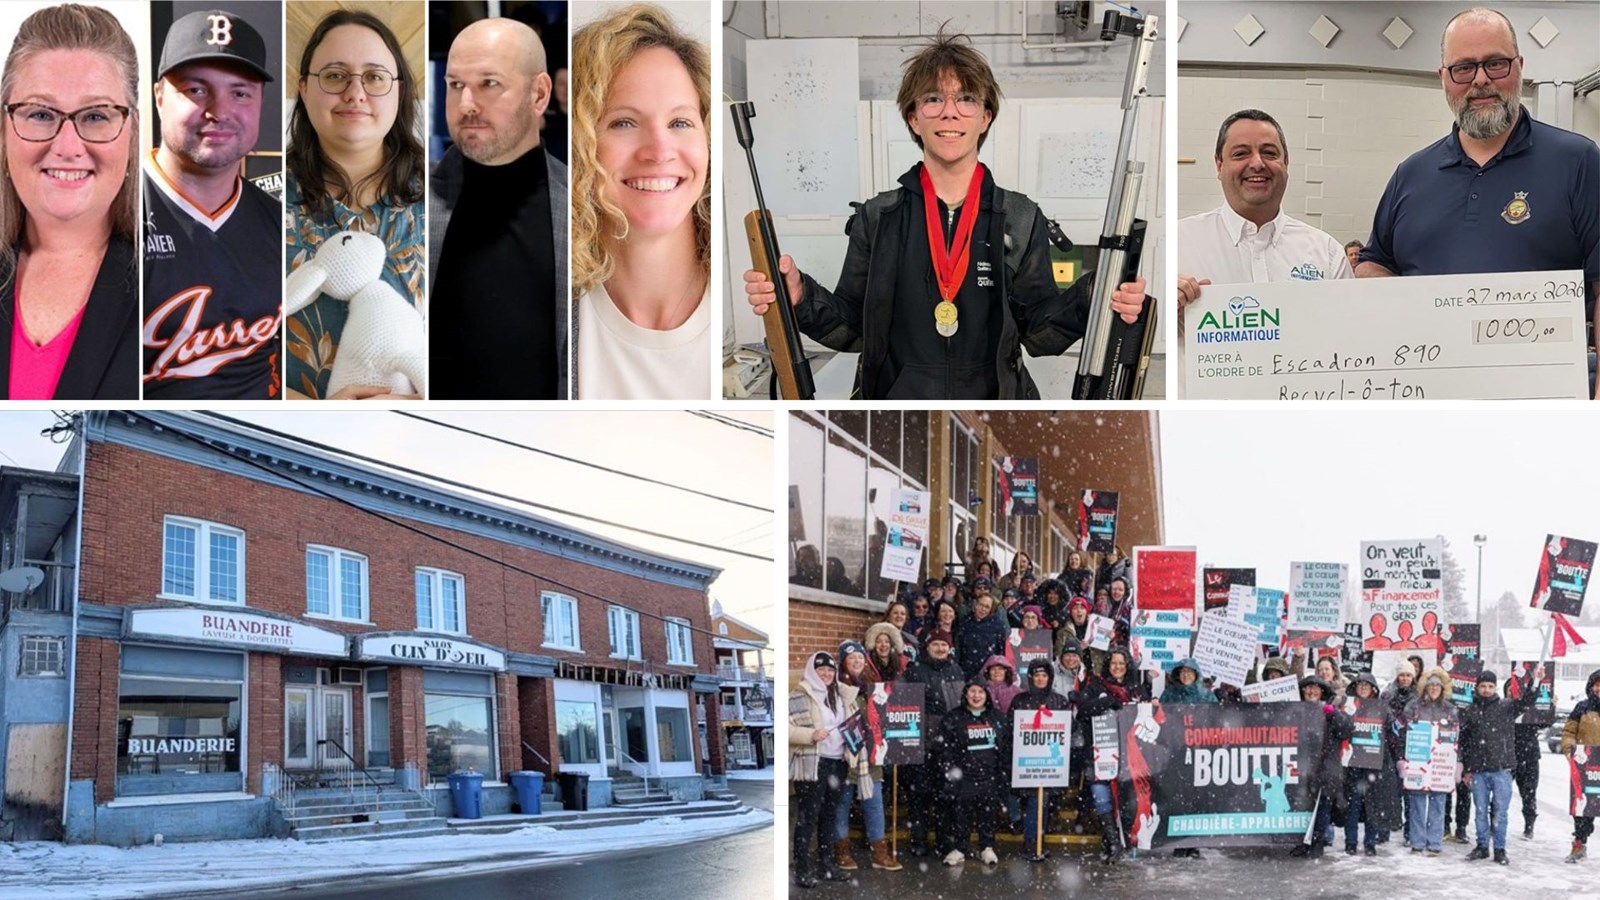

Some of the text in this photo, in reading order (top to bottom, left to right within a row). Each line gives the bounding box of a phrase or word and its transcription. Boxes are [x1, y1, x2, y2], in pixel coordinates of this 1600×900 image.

[206, 15, 233, 45] B
[1434, 280, 1584, 308] DATE 27 mars 2026
[1197, 329, 1280, 344] INFORMATIQUE
[1198, 351, 1243, 364] PAYER À
[1198, 344, 1441, 378] L'ORDRE DE Escadron 890
[1366, 545, 1387, 559] On
[1385, 560, 1401, 568] on
[1364, 567, 1379, 578] On
[1400, 580, 1432, 589] mieux
[1398, 602, 1418, 611] tous
[1392, 612, 1416, 621] GENS
[202, 615, 293, 638] BUANDERIE
[1214, 626, 1223, 634] LE
[391, 643, 426, 659] CLIN
[424, 640, 452, 649] SALON
[1215, 648, 1243, 661] VENTRE
[1213, 658, 1230, 668] VIDE
[889, 711, 920, 722] BOUTTE
[1184, 714, 1193, 726] LE
[1023, 731, 1065, 746] BOUTTE
[1184, 726, 1299, 746] COMMUNAUTAIRE
[128, 738, 235, 753] BUANDERIE
[1184, 747, 1299, 787] À BOUTTE
